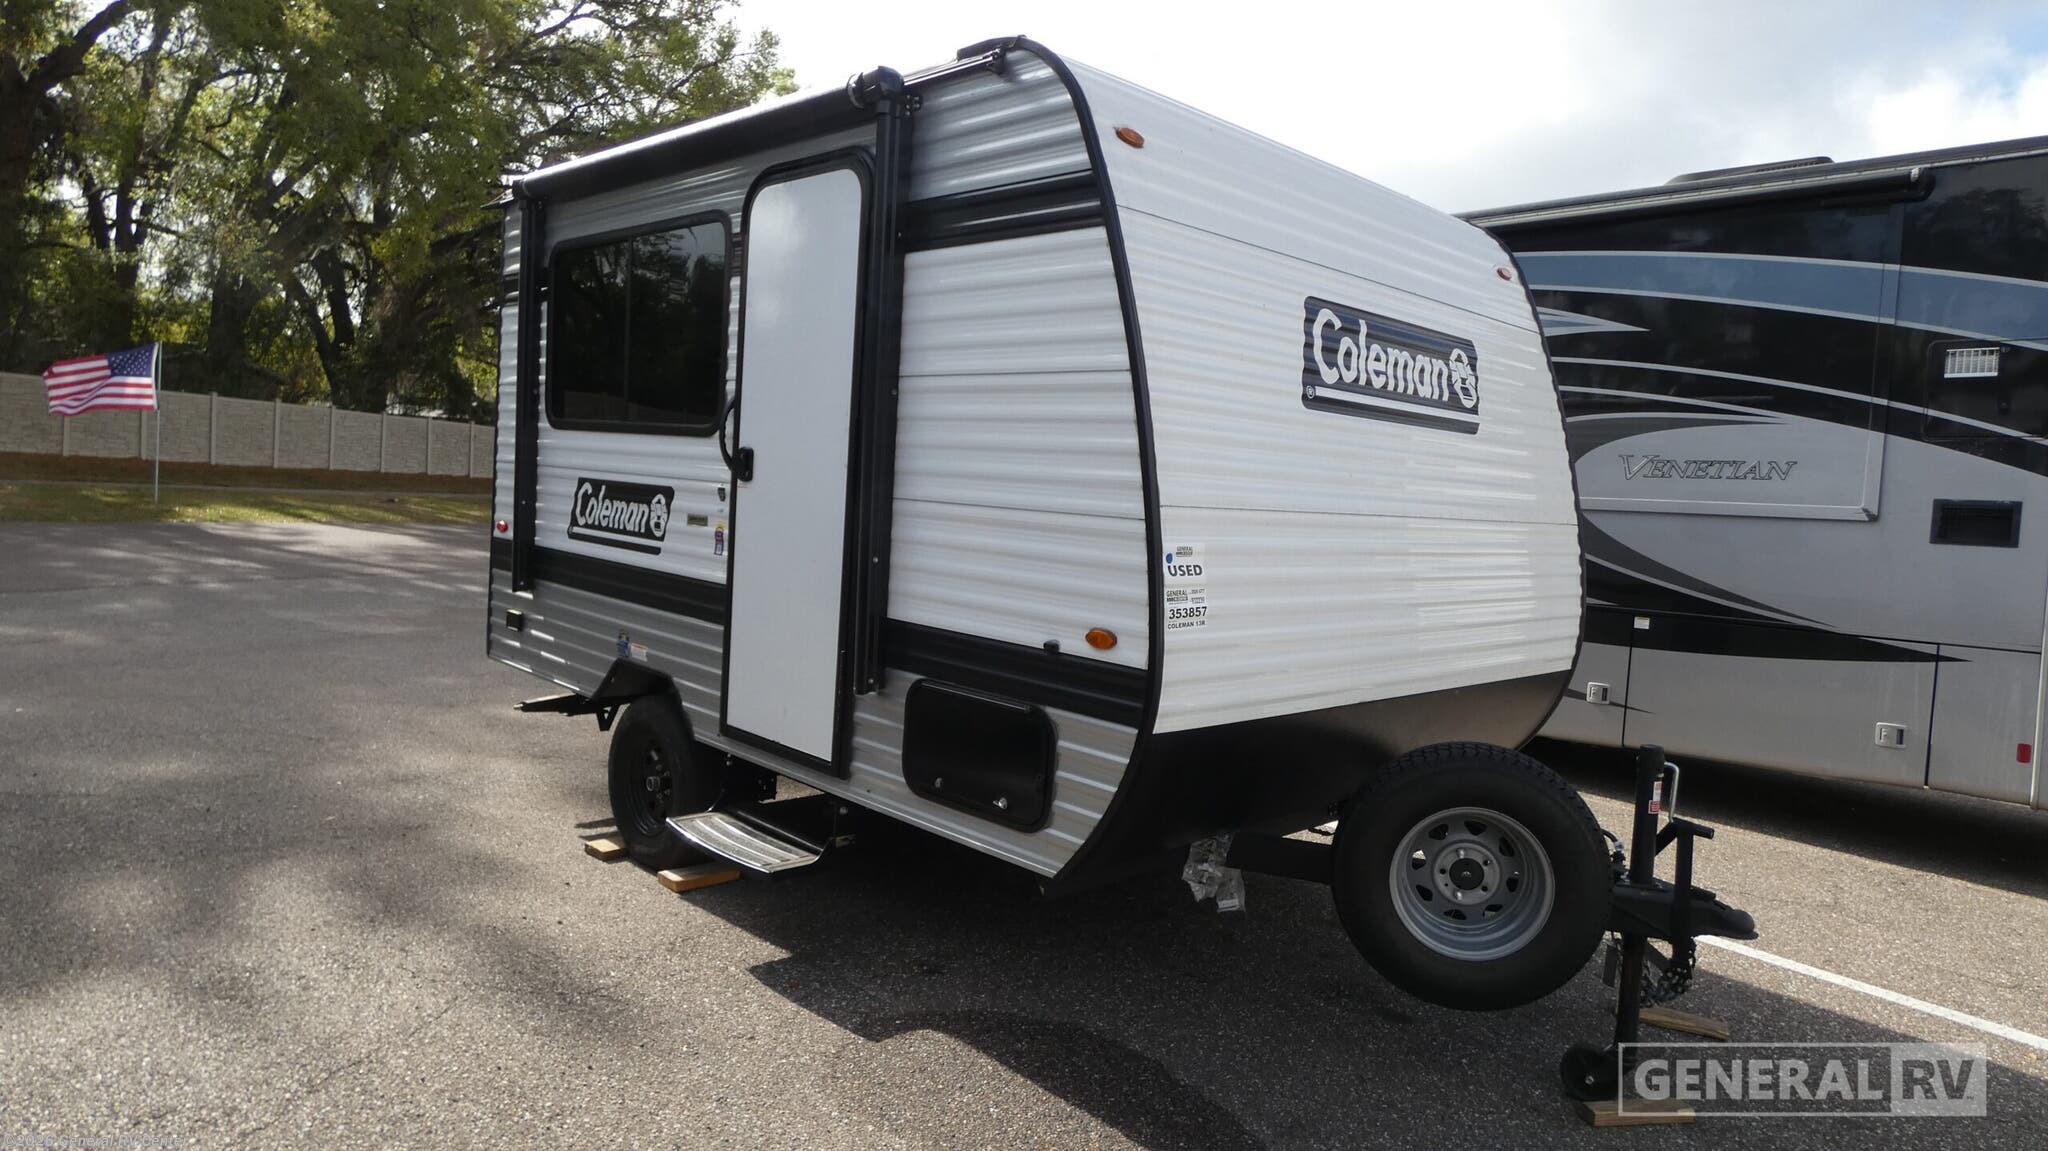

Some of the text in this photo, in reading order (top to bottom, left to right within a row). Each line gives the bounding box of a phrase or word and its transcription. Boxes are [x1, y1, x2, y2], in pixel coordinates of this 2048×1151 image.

[1313, 308, 1449, 402] Coleman
[1618, 454, 1798, 480] VENETIAN
[576, 482, 649, 533] Coleman
[1167, 564, 1203, 577] USED
[1169, 606, 1207, 619] 353857
[1167, 621, 1194, 630] COLEMAN
